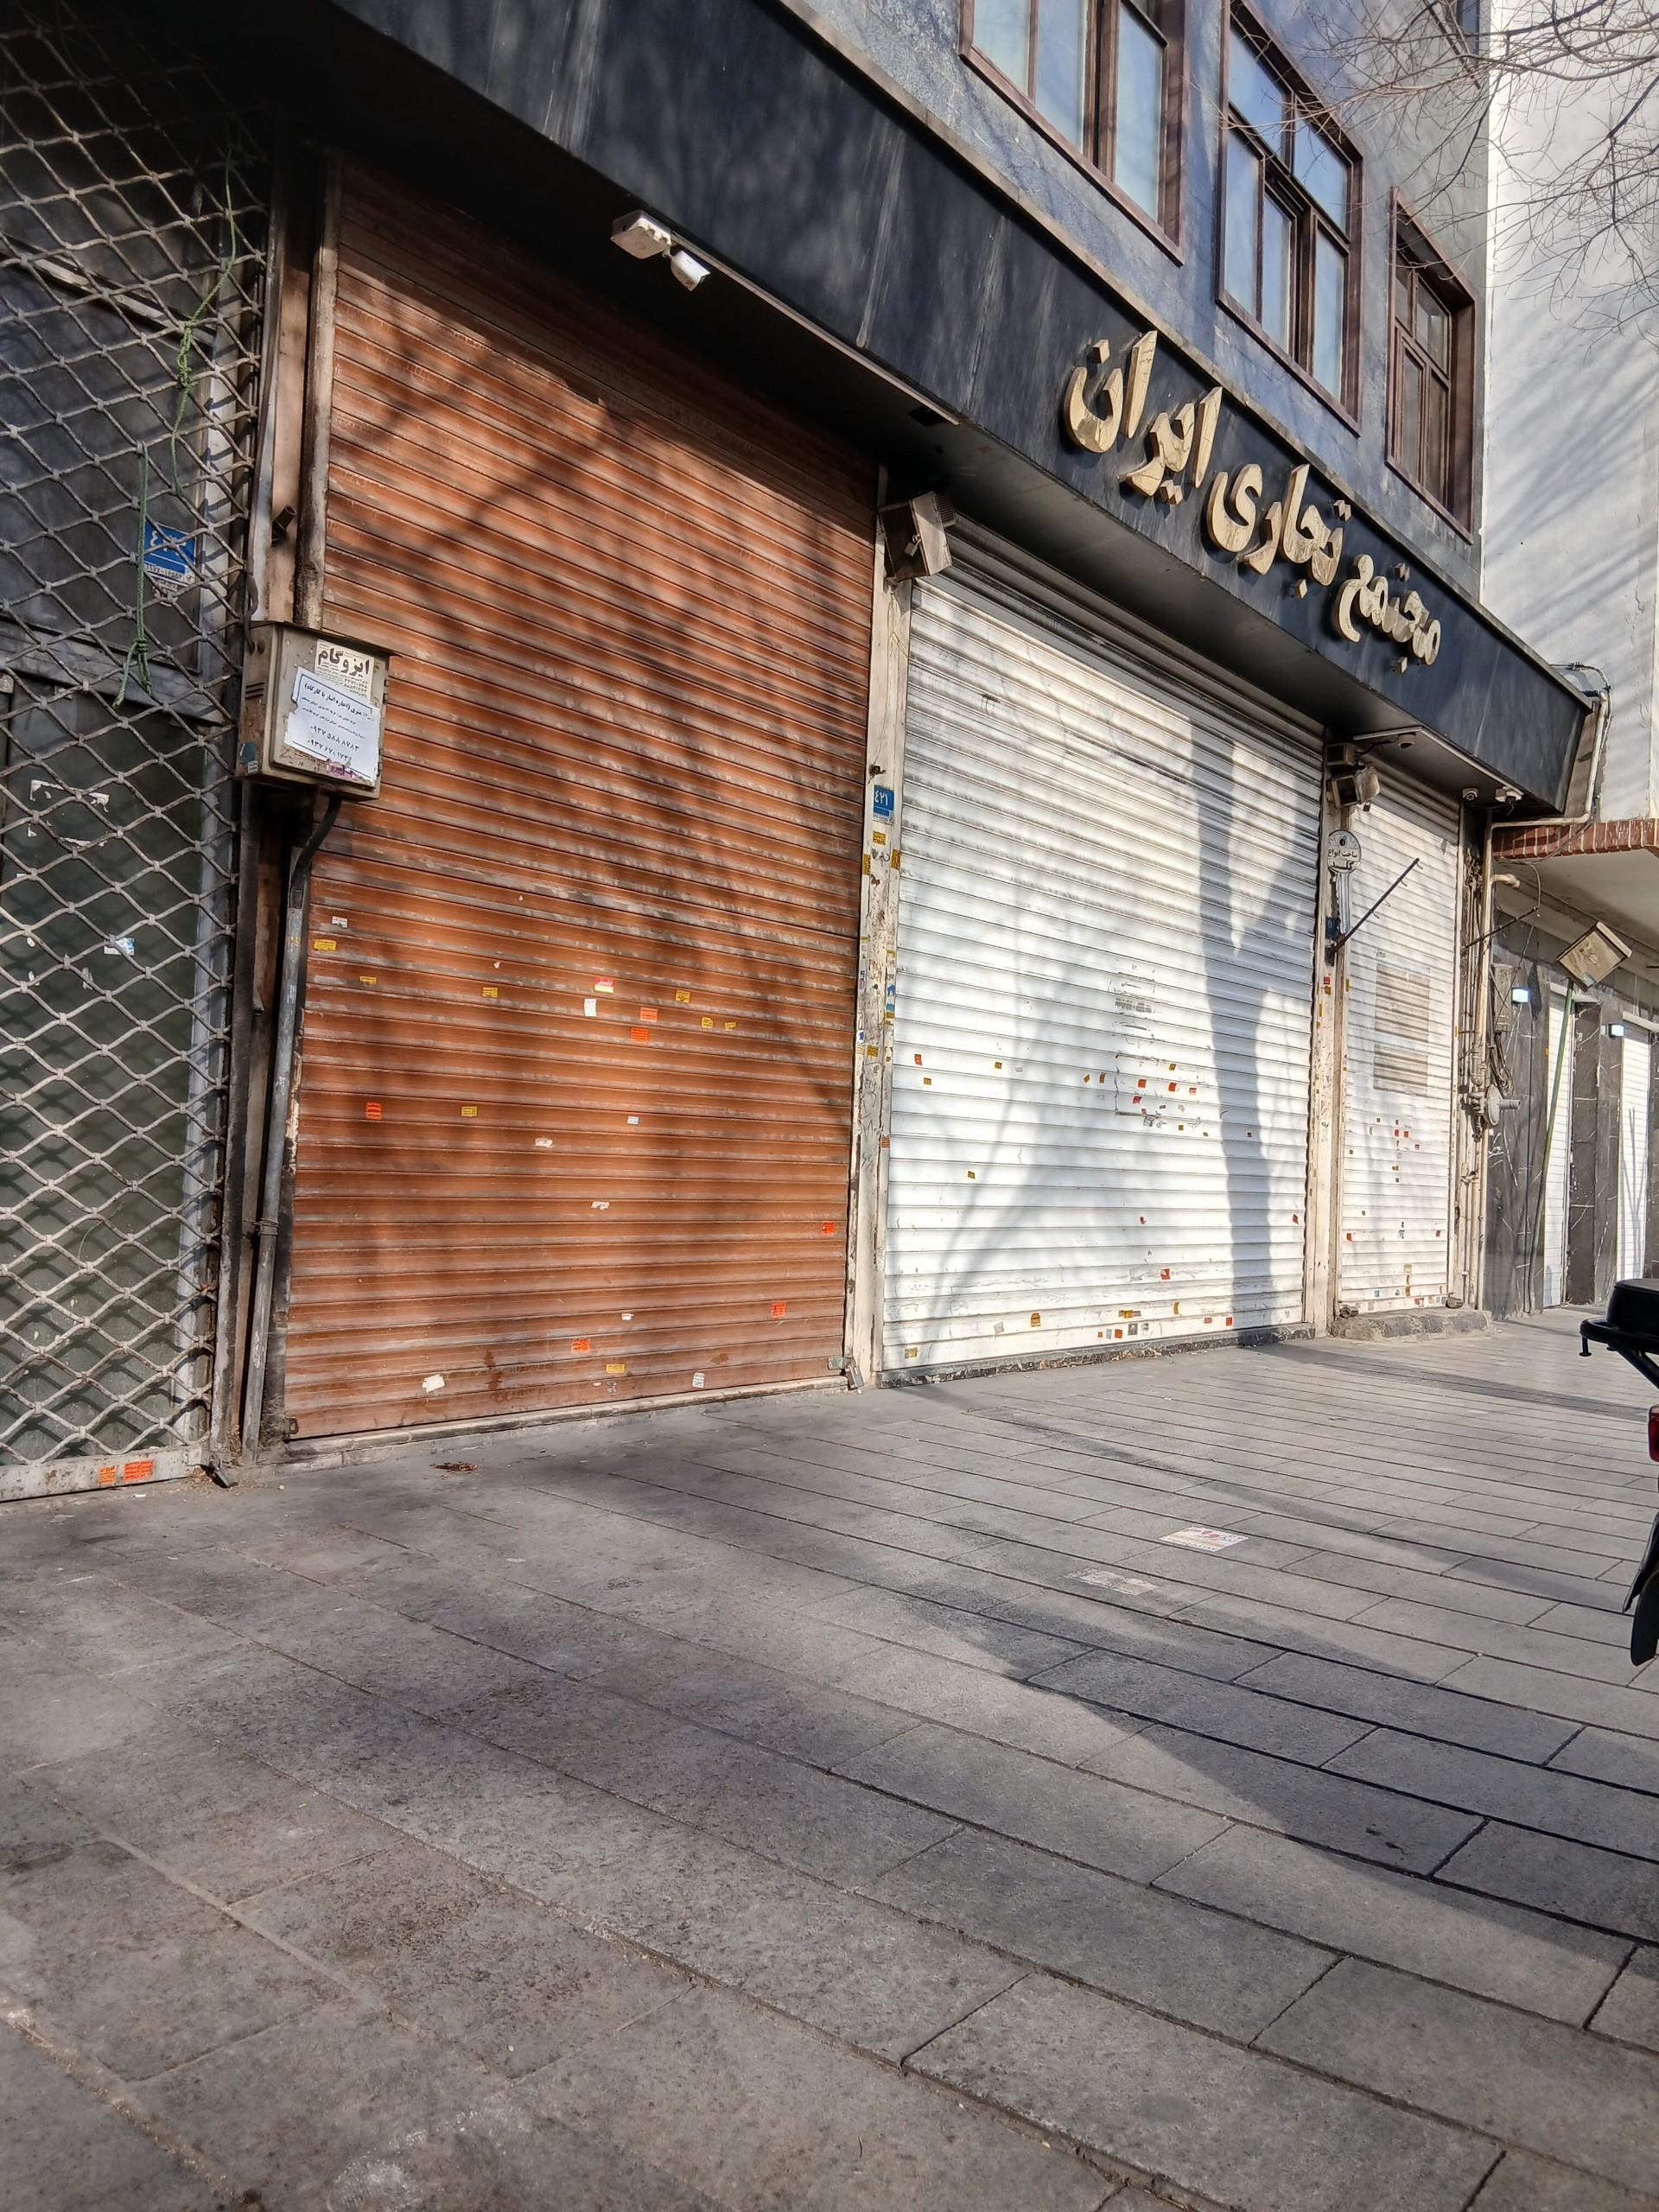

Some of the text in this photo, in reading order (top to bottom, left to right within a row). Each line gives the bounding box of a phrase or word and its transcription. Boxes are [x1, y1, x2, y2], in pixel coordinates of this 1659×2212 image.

[1064, 330, 1441, 673] مجتمع تجاری ایران
[318, 648, 370, 677] ایزوگام
[1327, 849, 1341, 857] انواع
